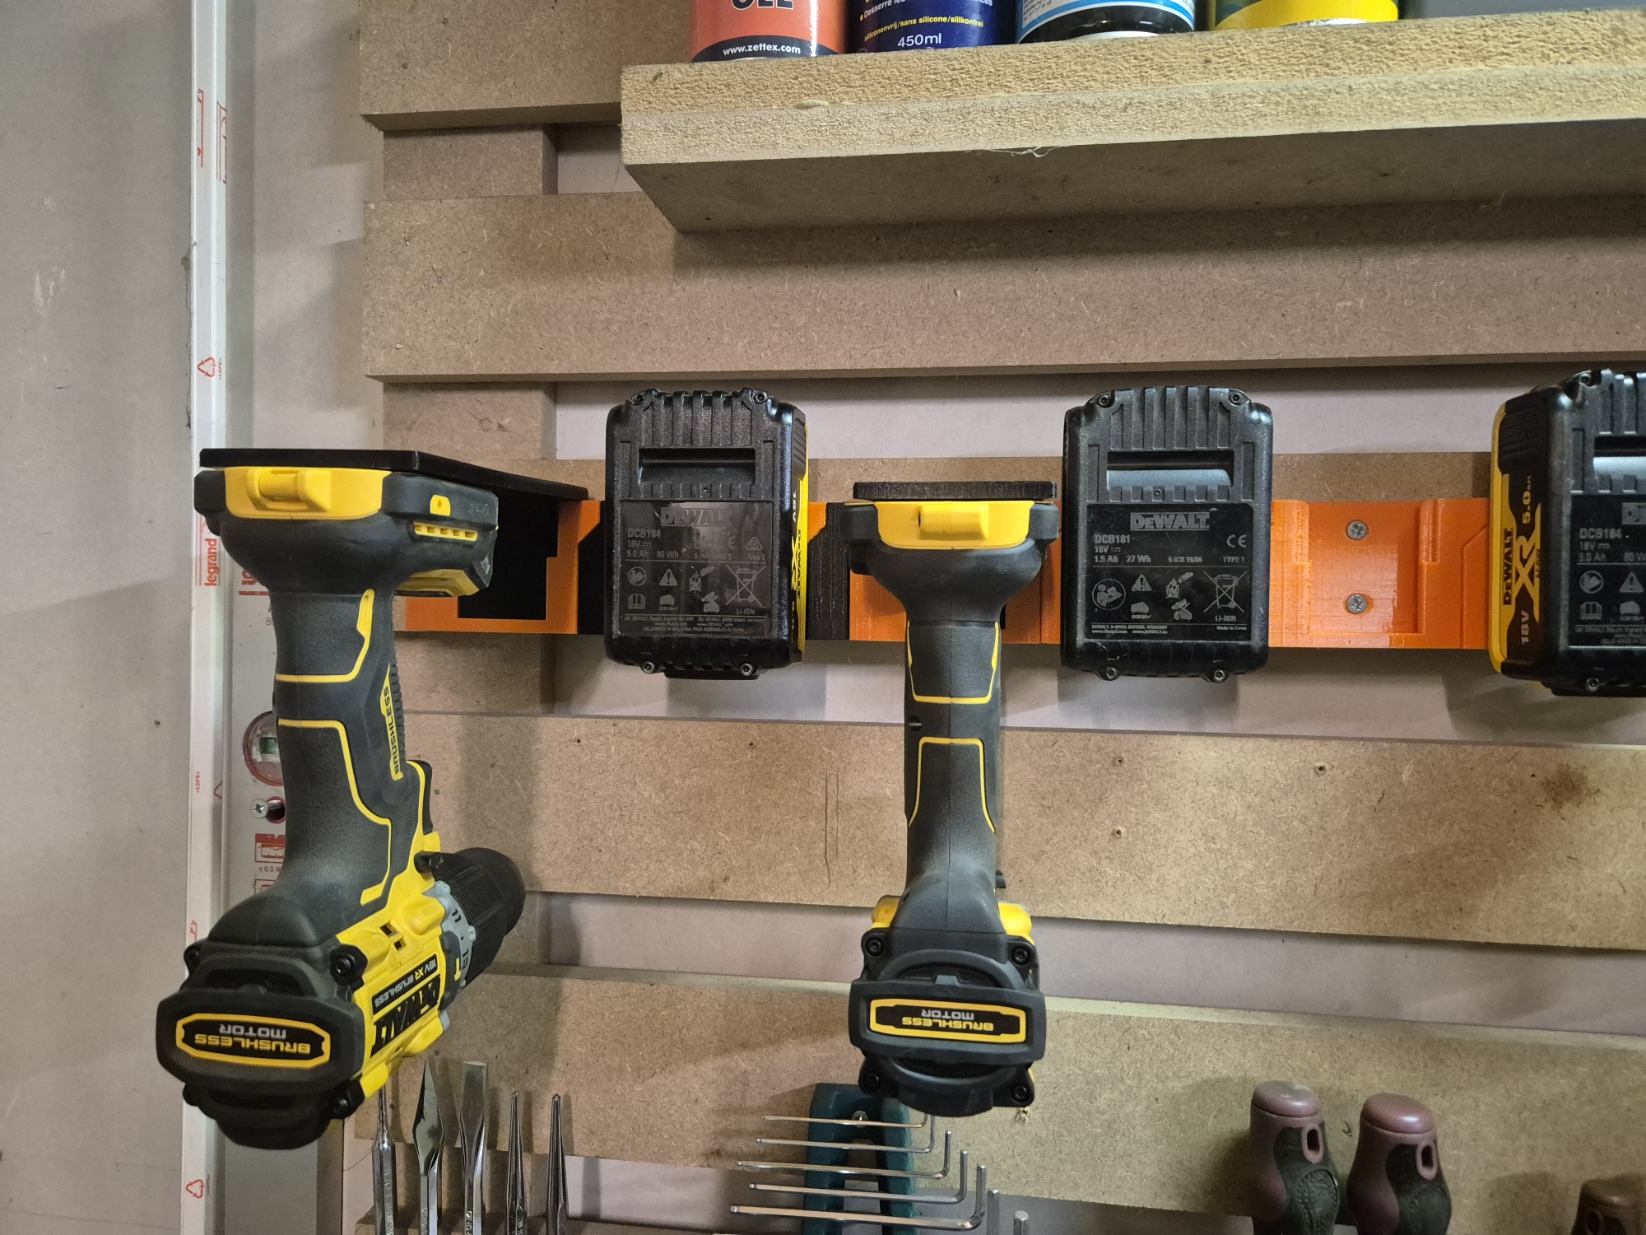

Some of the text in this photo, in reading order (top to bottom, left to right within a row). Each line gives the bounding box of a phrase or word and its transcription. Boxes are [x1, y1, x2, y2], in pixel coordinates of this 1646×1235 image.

[918, 15, 984, 28] silicone/silikonfrei
[897, 33, 942, 48] 450ml
[723, 42, 801, 56] www.zettex.com
[1130, 512, 1209, 531] DEWALT
[627, 528, 661, 539] DCB184
[1094, 534, 1130, 544] DCB181
[1579, 528, 1622, 539] DCB184
[627, 540, 641, 548] 18V
[1094, 545, 1109, 553] 18V
[1579, 541, 1596, 550] 18V
[626, 550, 637, 558] 5.0
[1094, 555, 1151, 563] 1.5 Ah 27 Wh
[1578, 552, 1592, 562] 5.0
[1593, 552, 1607, 562] Ah
[204, 538, 221, 587] legrand
[1502, 528, 1513, 606] DEWALT
[1520, 610, 1530, 645] 18V
[383, 687, 399, 773] BRUSHLESS
[451, 909, 462, 923] 11
[374, 958, 436, 1008] 18V XR BRUSHLESS
[370, 974, 441, 1057] DEWALT
[921, 1009, 974, 1021] MOTOR
[902, 1017, 994, 1031] BRUSHLESS
[219, 1023, 287, 1040] MOTOR
[194, 1033, 311, 1055] BRUSHLESS
